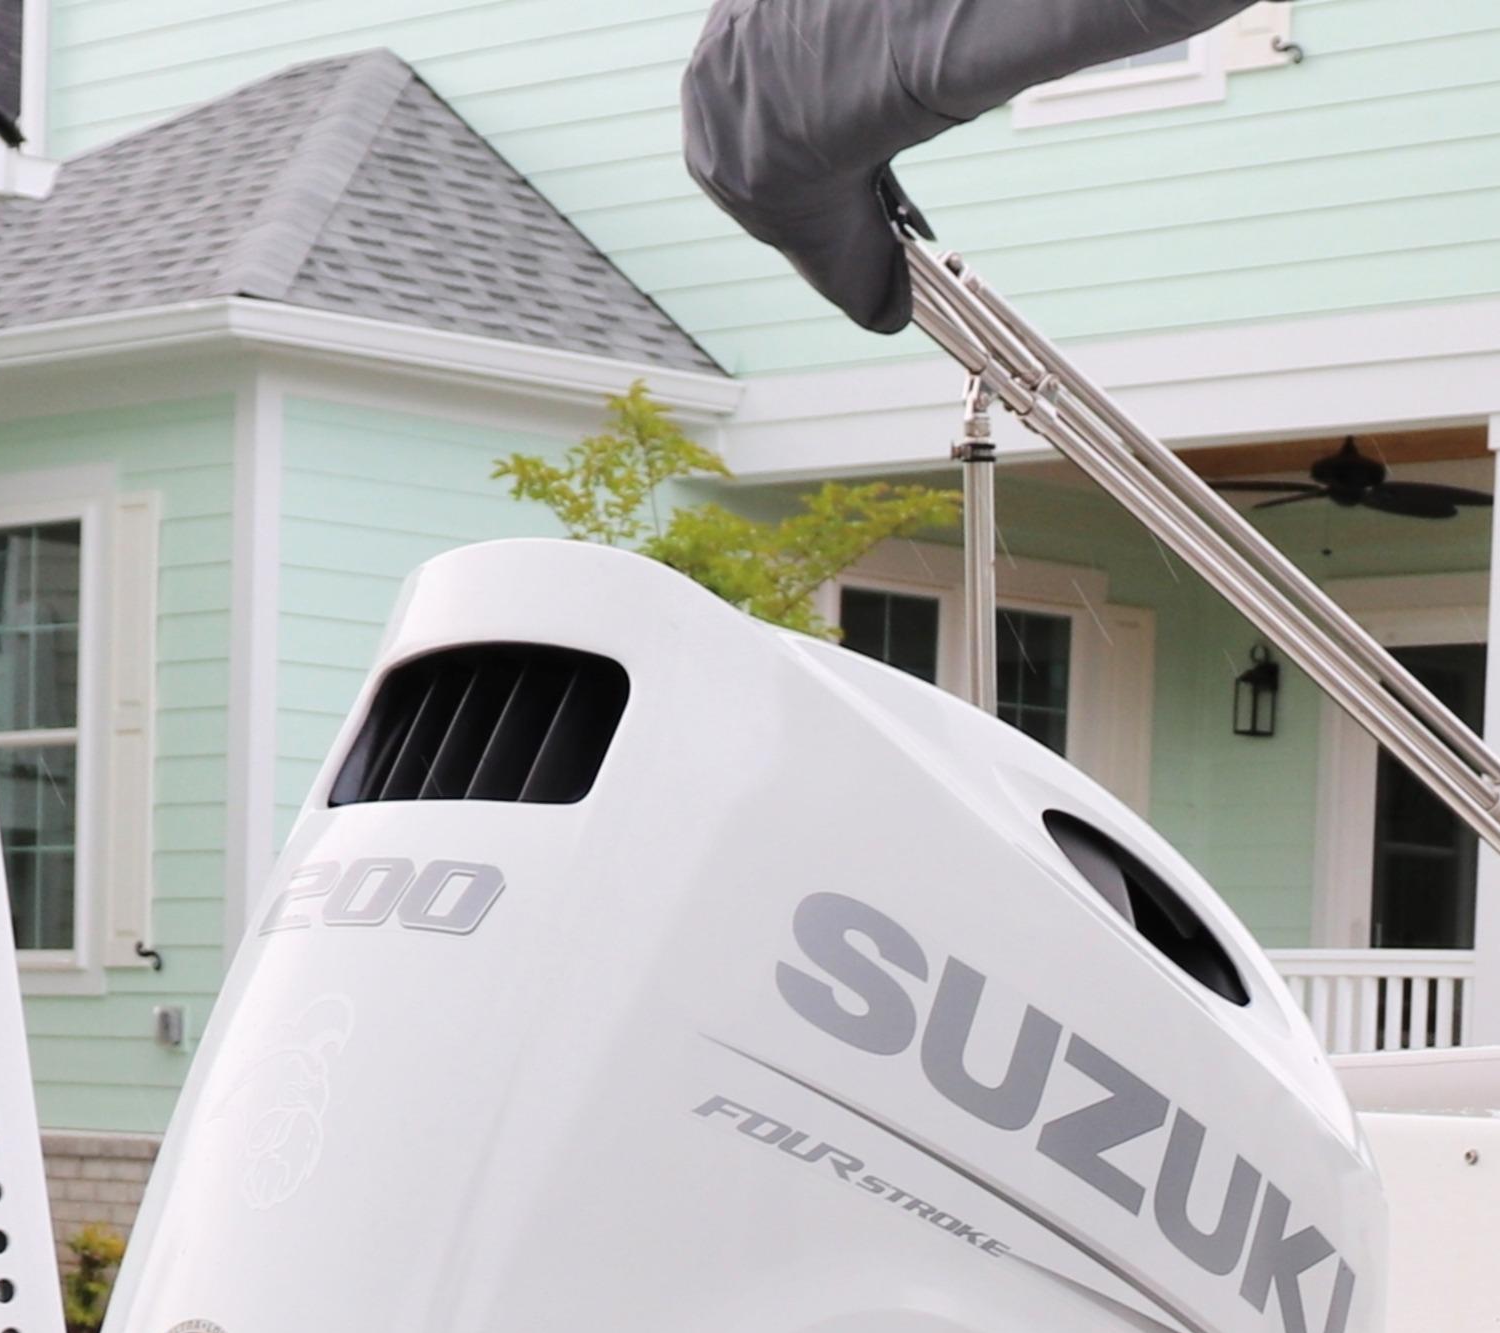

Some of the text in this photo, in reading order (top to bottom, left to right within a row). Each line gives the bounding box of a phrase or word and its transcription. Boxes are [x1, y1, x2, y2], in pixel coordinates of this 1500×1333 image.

[258, 857, 506, 936] 200
[692, 1095, 1011, 1258] FOUR STROKE
